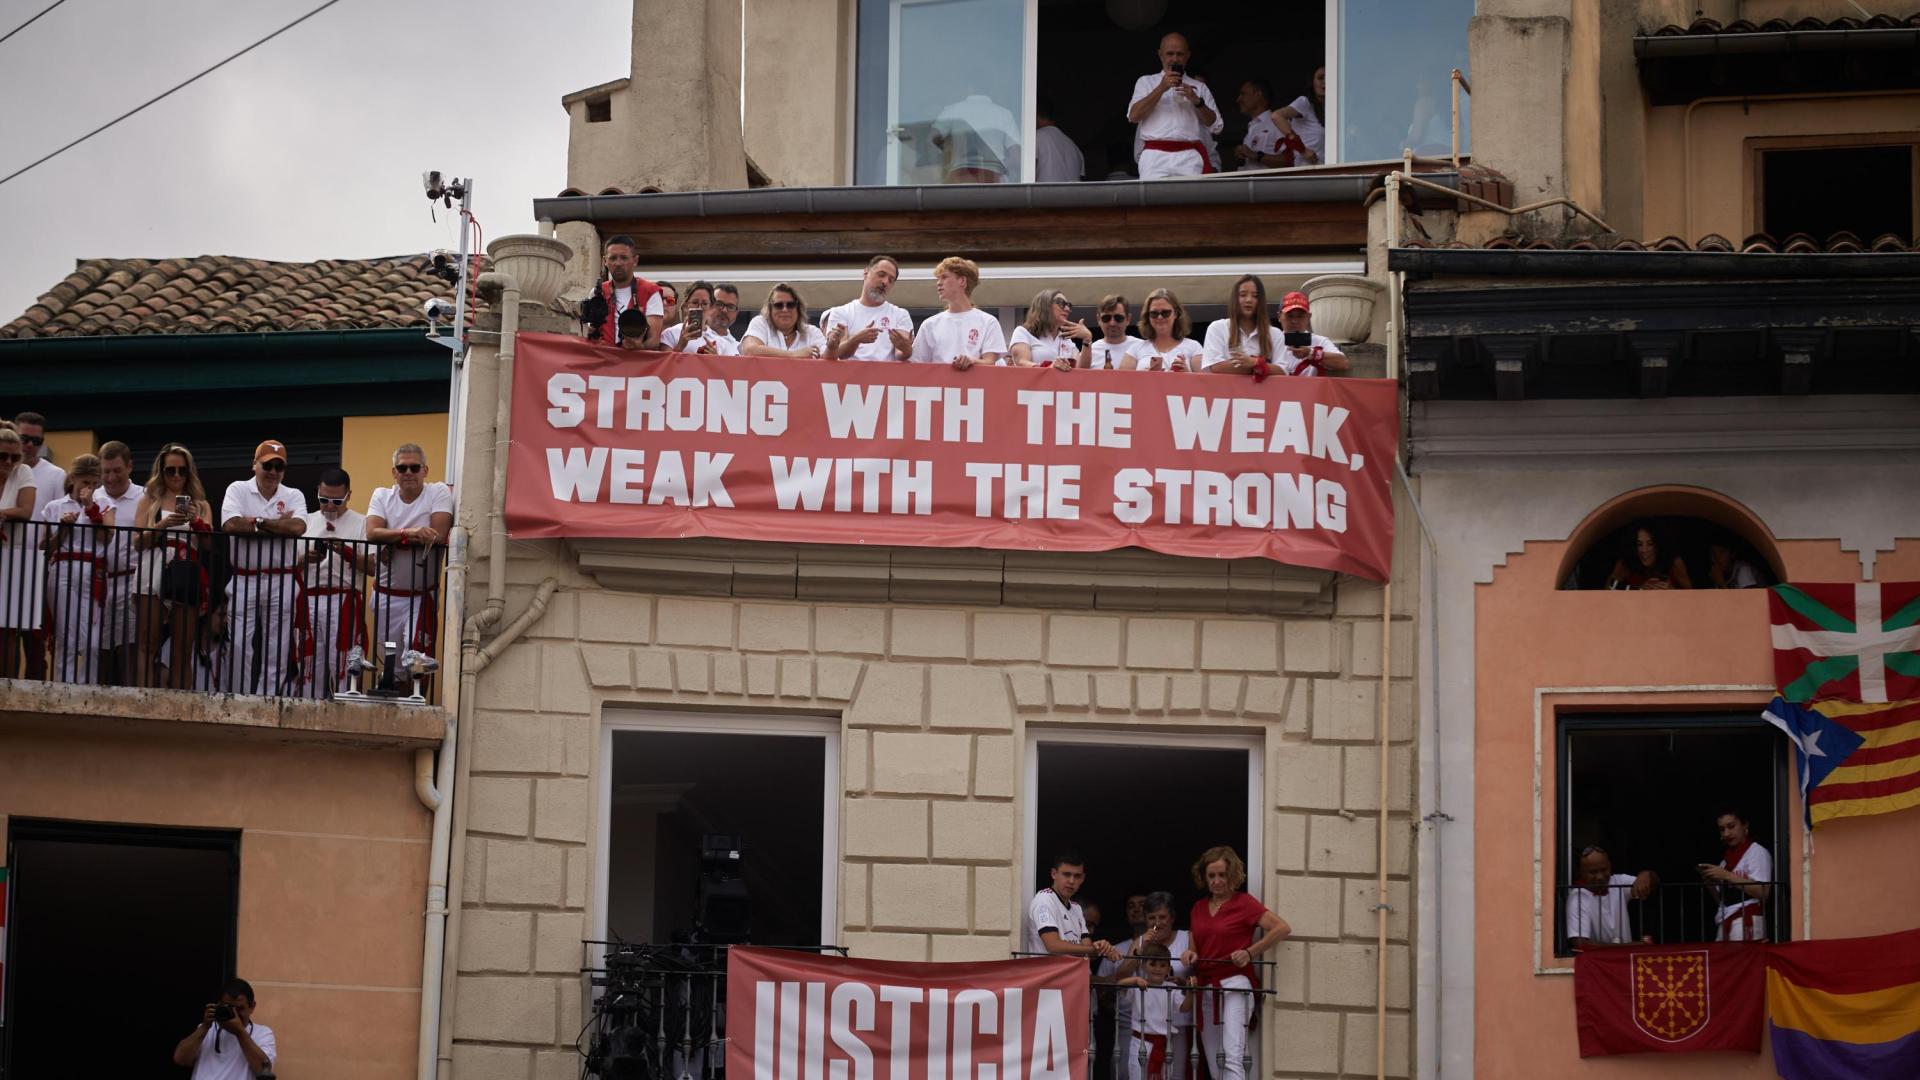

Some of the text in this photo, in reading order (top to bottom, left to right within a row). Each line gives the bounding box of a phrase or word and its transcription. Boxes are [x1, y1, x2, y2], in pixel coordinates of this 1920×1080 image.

[546, 372, 1364, 471] STRONG WITH THE WEAK,
[545, 446, 1348, 533] WEAK WITH THE STRONG
